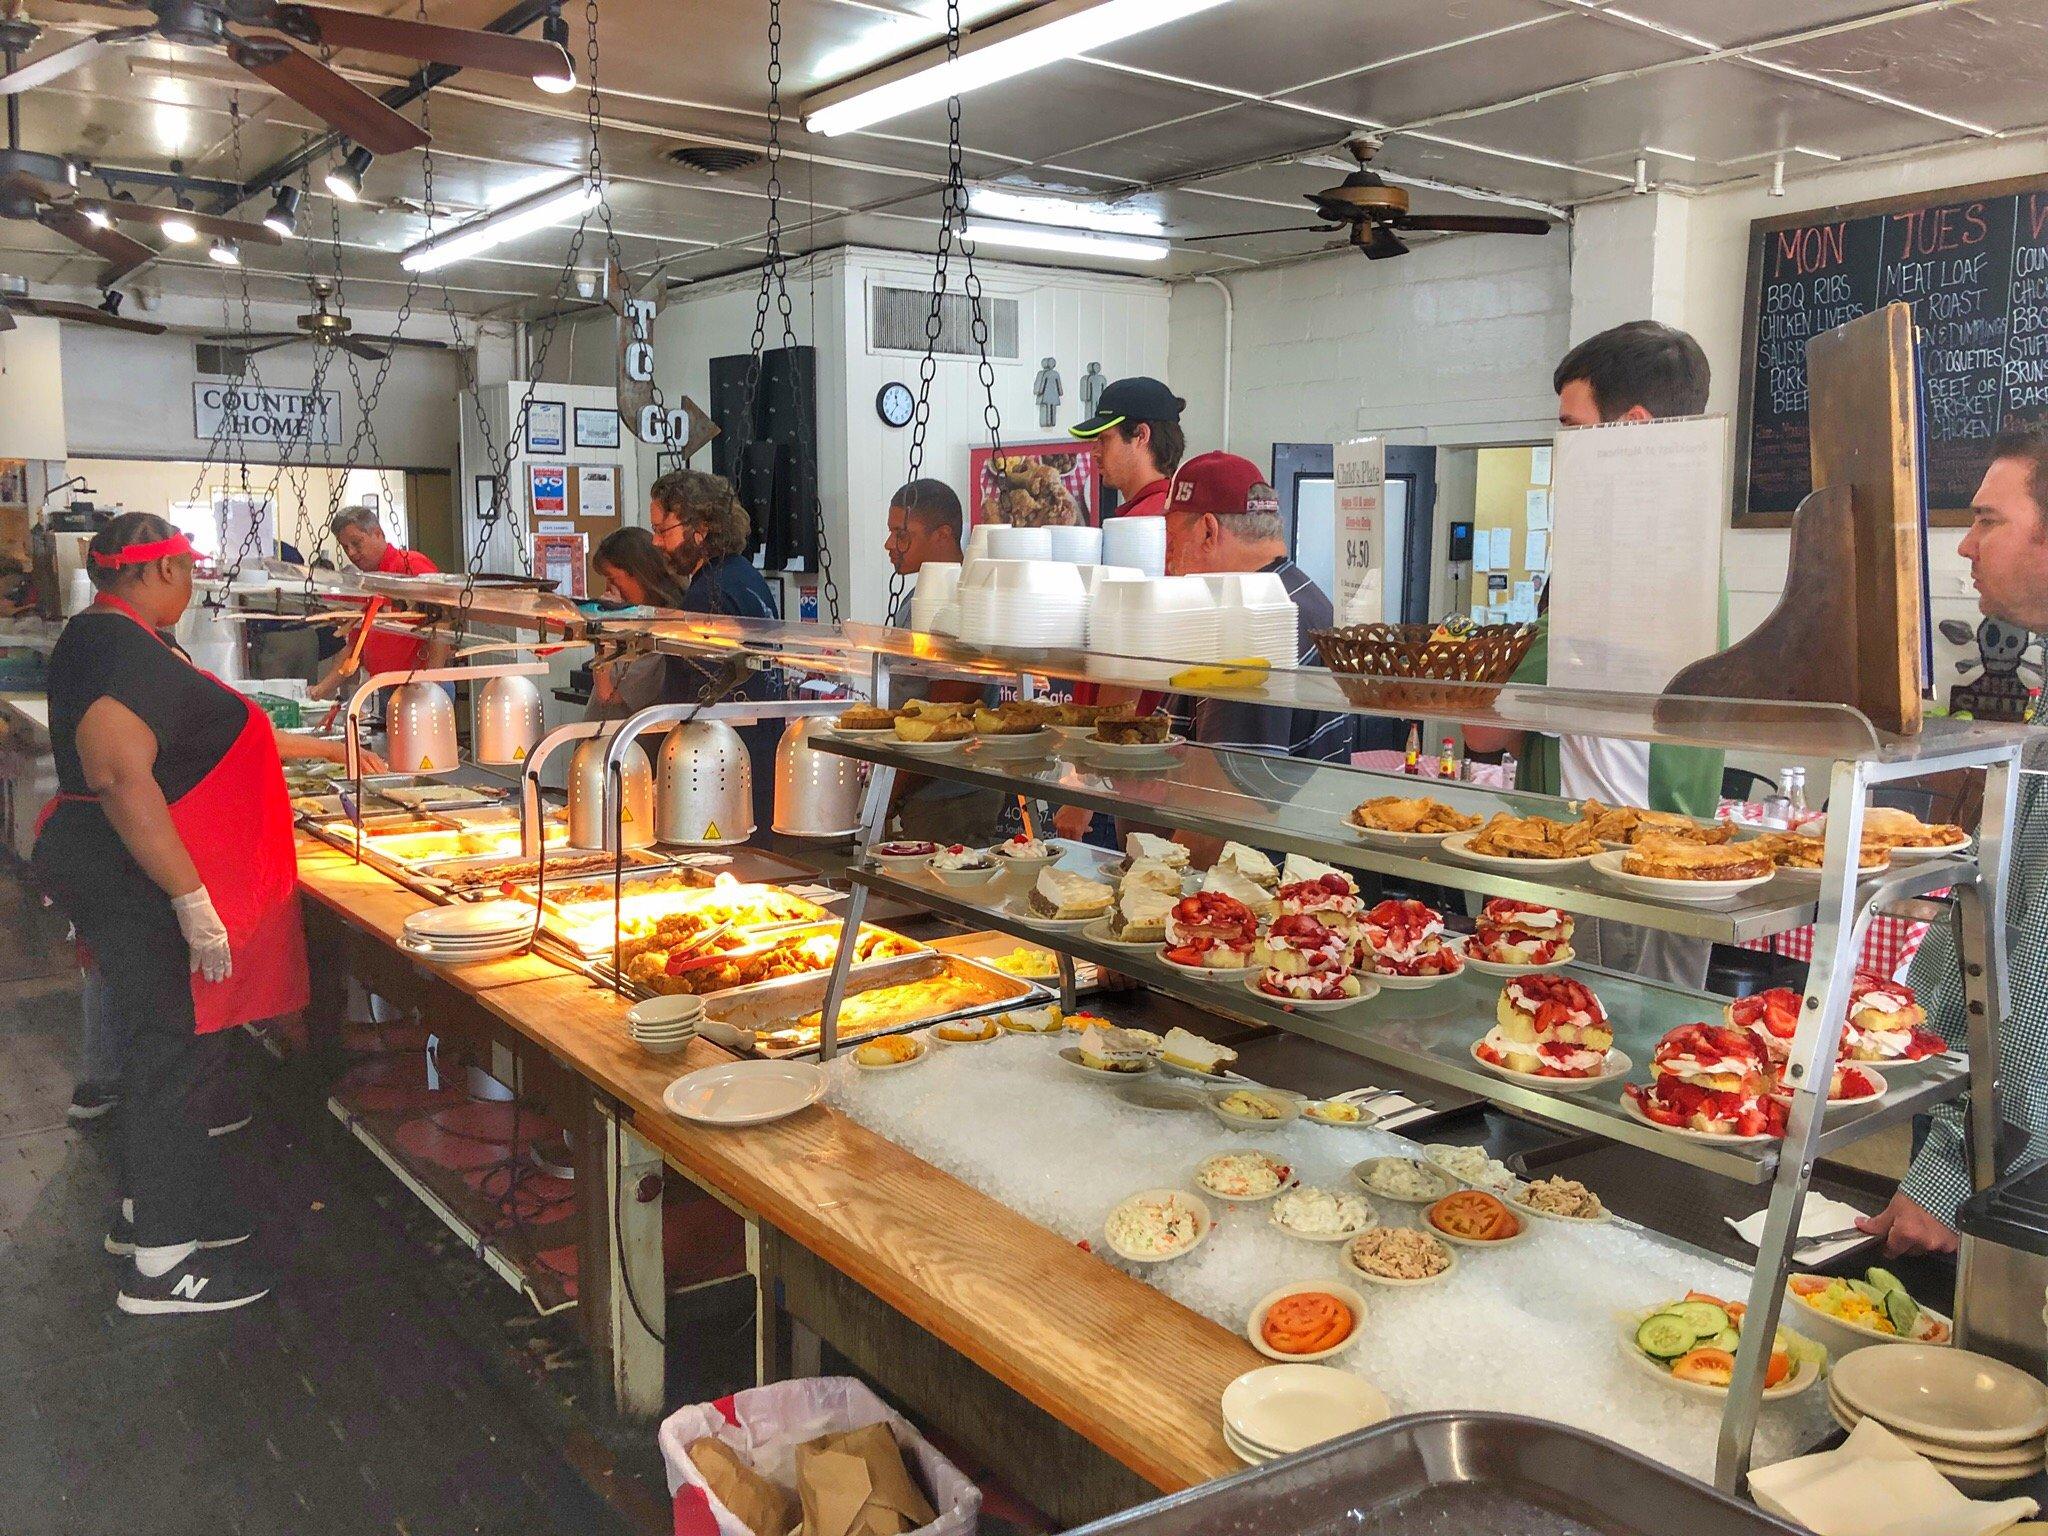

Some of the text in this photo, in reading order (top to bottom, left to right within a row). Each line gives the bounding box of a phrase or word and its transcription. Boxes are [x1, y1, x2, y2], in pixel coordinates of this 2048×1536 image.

[1893, 203, 1988, 259] TUES
[1775, 222, 1846, 277] MON
[1886, 252, 1988, 296] MEAT LOAF
[1767, 274, 1851, 313] BBQ RIBS
[1930, 289, 1988, 320] ROAST
[1761, 309, 1811, 342] CHICKEN
[1817, 303, 1864, 331] LIVERS
[1929, 347, 2003, 376] CROQUETTES
[1771, 366, 1808, 393] PORK
[1928, 375, 1997, 398] BEEF OR
[203, 390, 332, 415] COUNTRY
[1931, 394, 1996, 420] BRISKET
[231, 415, 310, 437] HOME
[637, 404, 690, 447] GO
[1931, 416, 1993, 440] CHICKEN
[1361, 460, 1380, 484] Plate
[1346, 539, 1370, 568] $4.50
[170, 1274, 209, 1299] N
